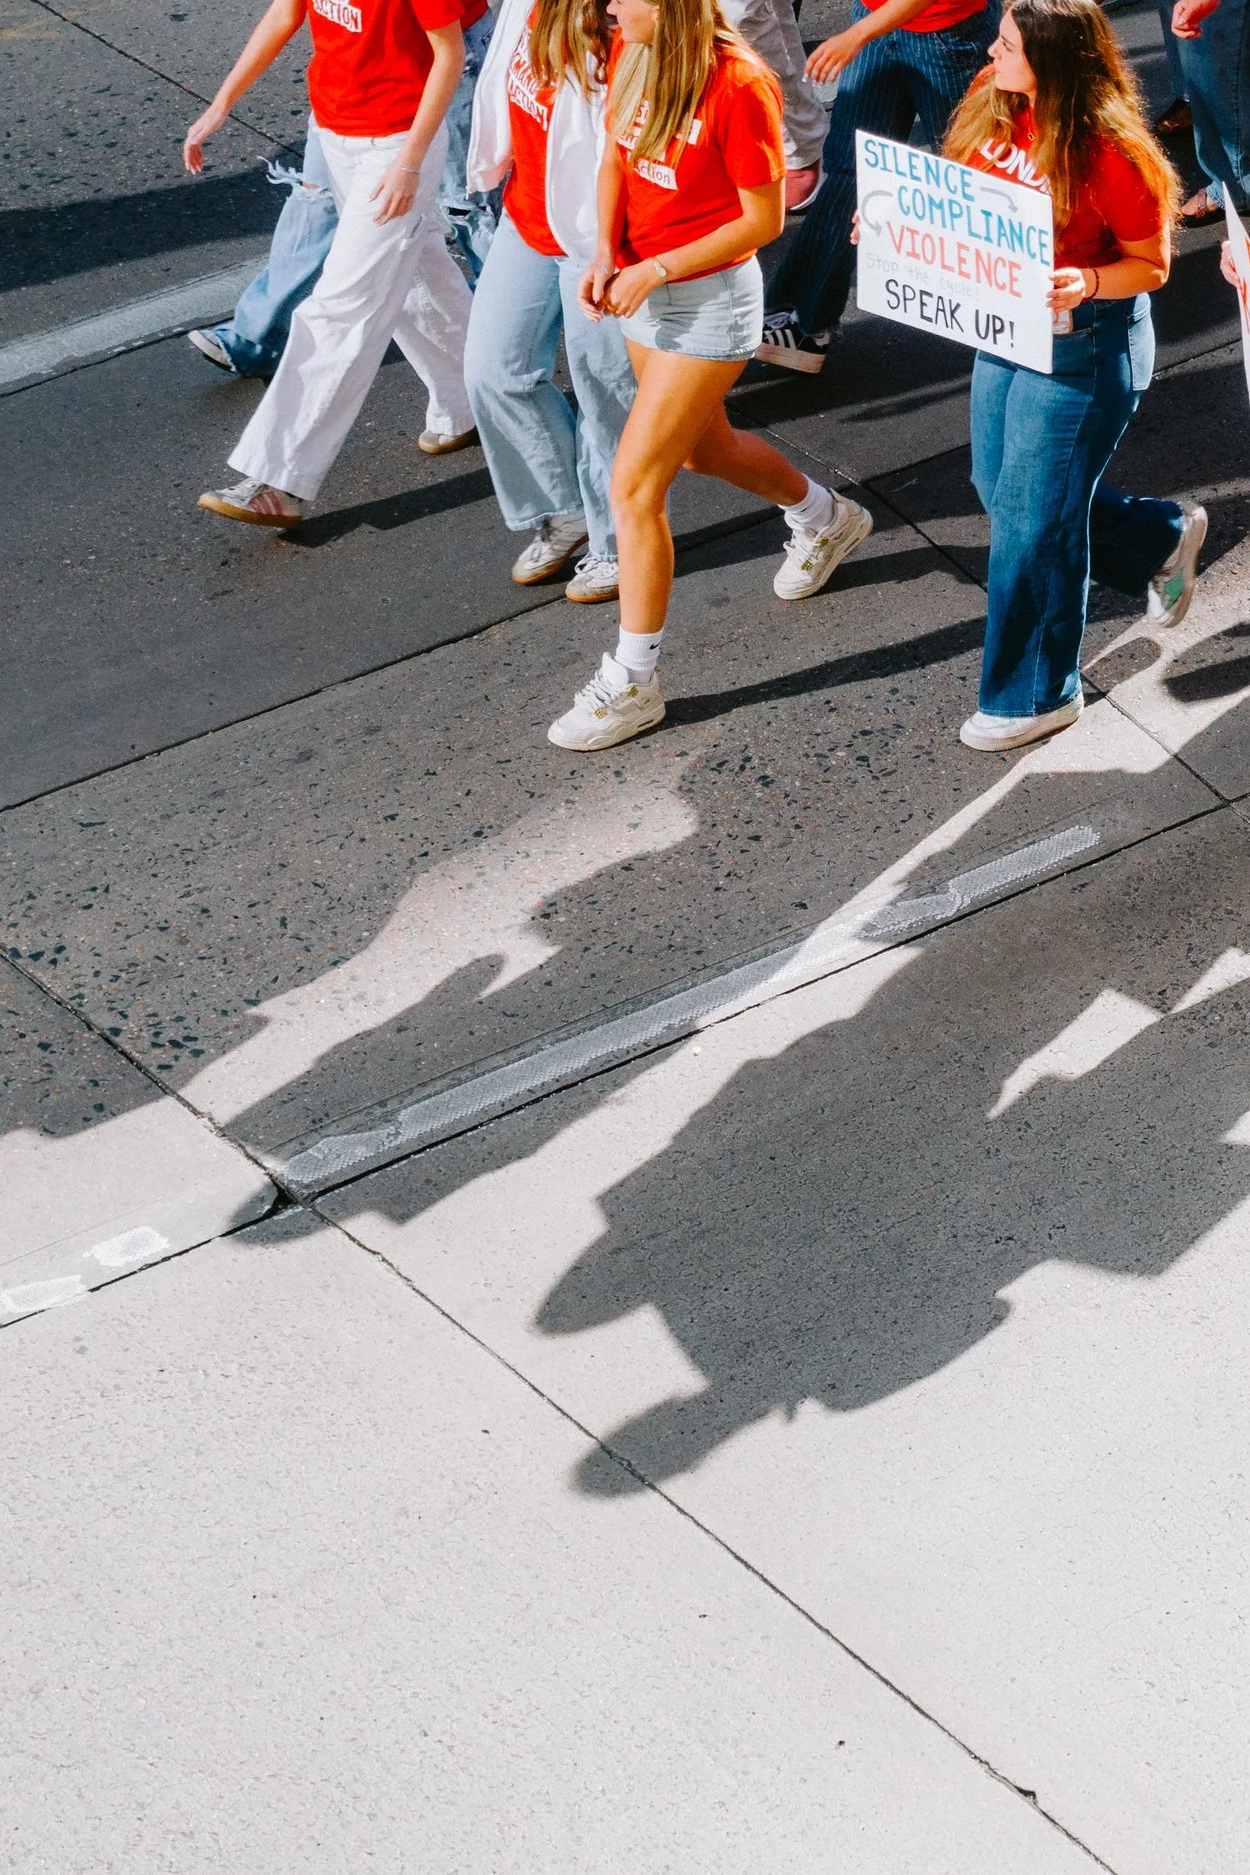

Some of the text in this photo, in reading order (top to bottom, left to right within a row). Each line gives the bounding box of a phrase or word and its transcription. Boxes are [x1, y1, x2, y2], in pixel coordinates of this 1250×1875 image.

[864, 138, 976, 203] SILENCE
[886, 220, 1023, 299] VIOLENCE
[897, 184, 1051, 267] COMPLIANCE
[885, 278, 1016, 349] SPEAK UP!
